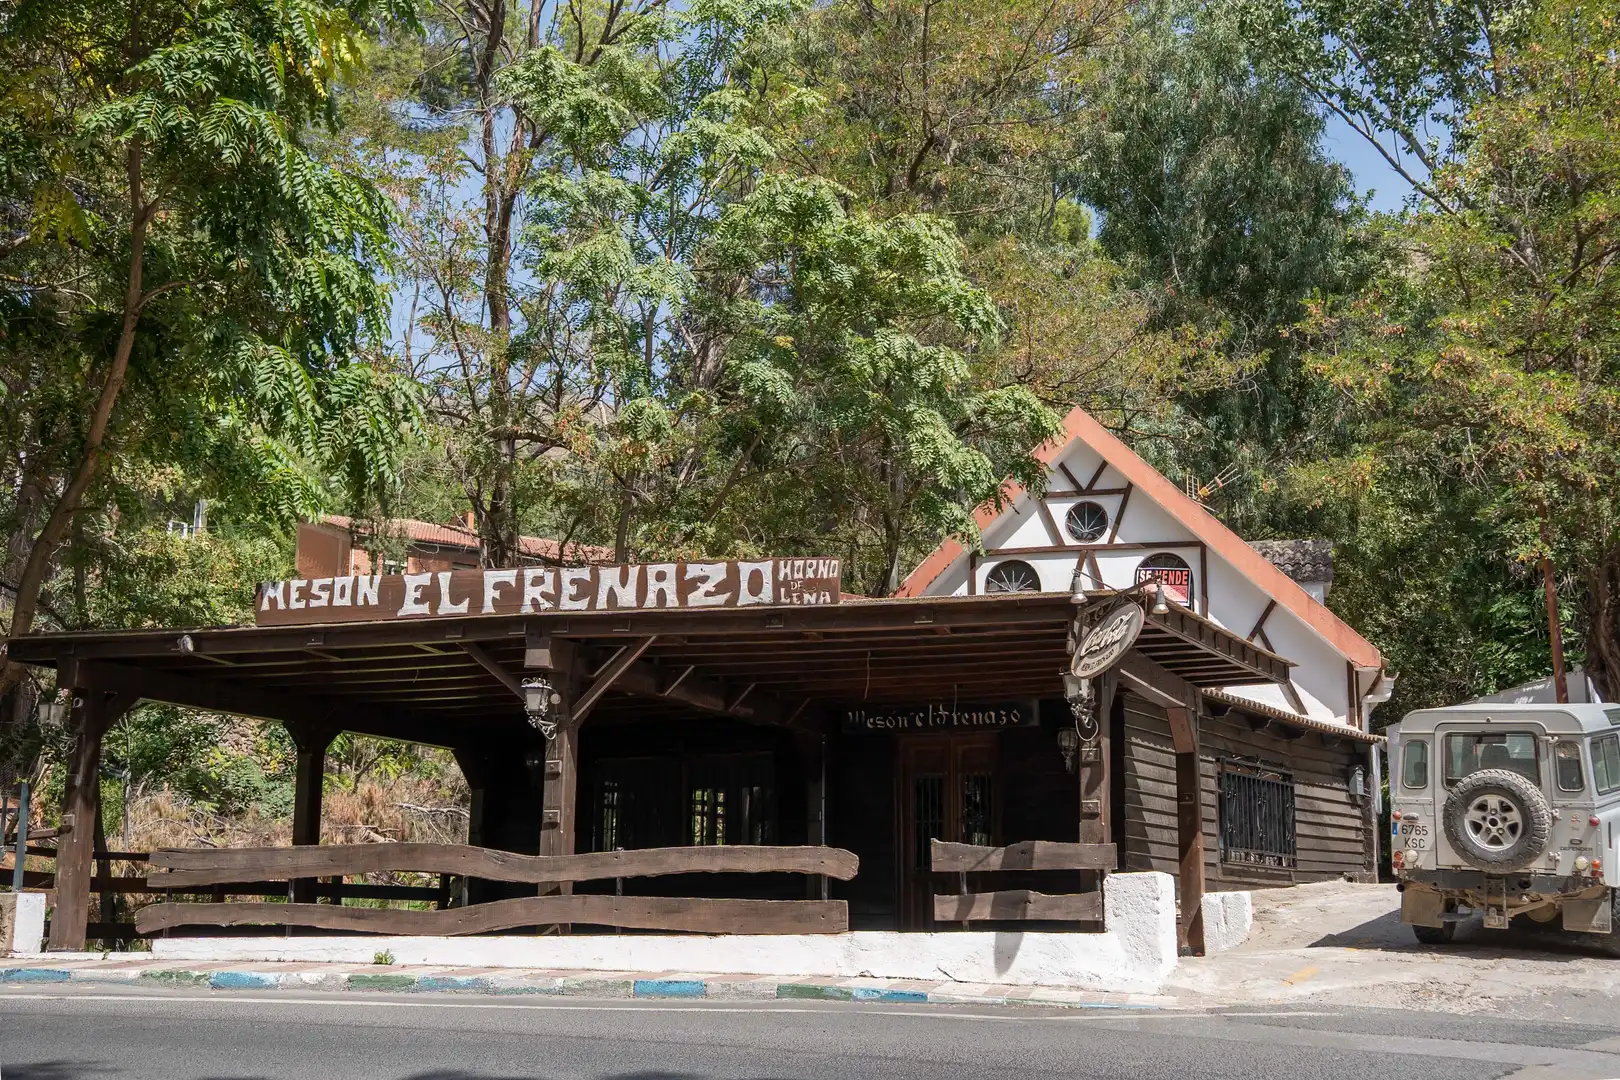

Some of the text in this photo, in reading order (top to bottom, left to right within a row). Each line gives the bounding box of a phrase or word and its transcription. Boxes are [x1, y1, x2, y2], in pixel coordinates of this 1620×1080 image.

[778, 559, 839, 581] HORNO
[260, 560, 774, 616] MESON EL FRENAZO
[790, 580, 803, 590] DE
[848, 709, 909, 729] Mesón
[1401, 824, 1428, 836] 6765
[1404, 837, 1425, 849] KSC
